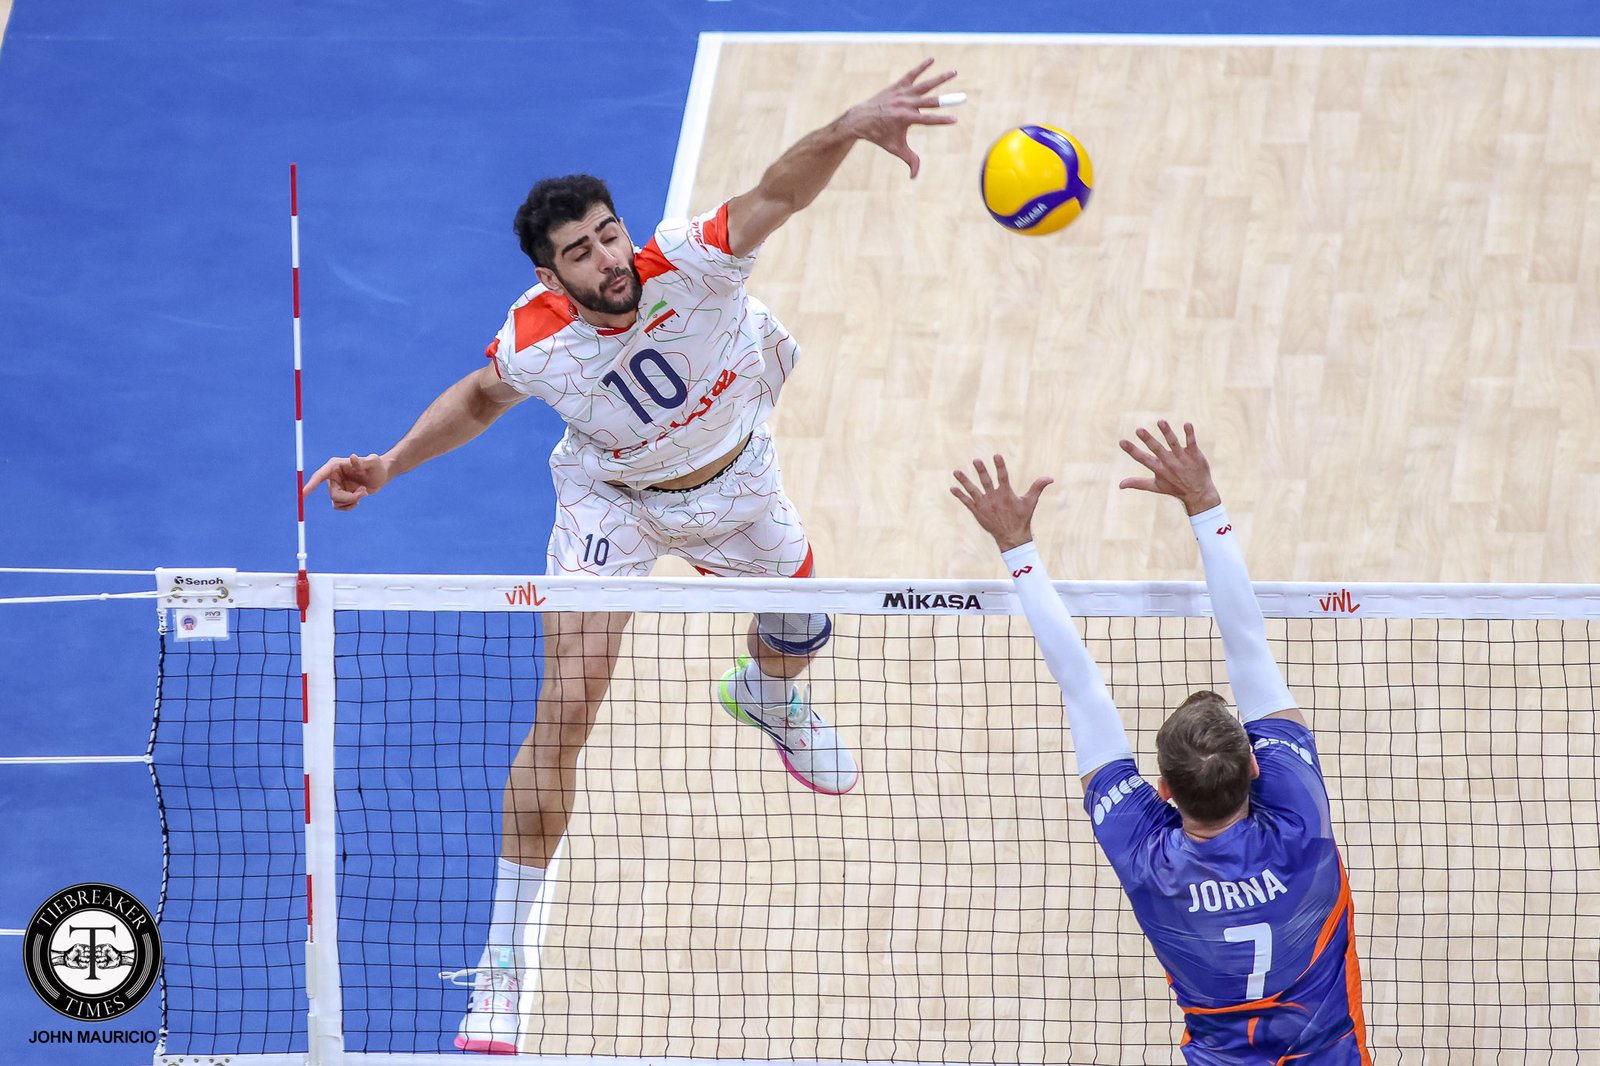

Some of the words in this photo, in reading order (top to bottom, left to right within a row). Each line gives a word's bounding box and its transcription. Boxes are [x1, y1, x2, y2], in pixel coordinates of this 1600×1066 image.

[602, 348, 688, 425] 10
[583, 533, 610, 567] 10
[185, 577, 224, 586] Senoh
[1188, 868, 1288, 913] JORNA
[1223, 922, 1272, 1000] 7
